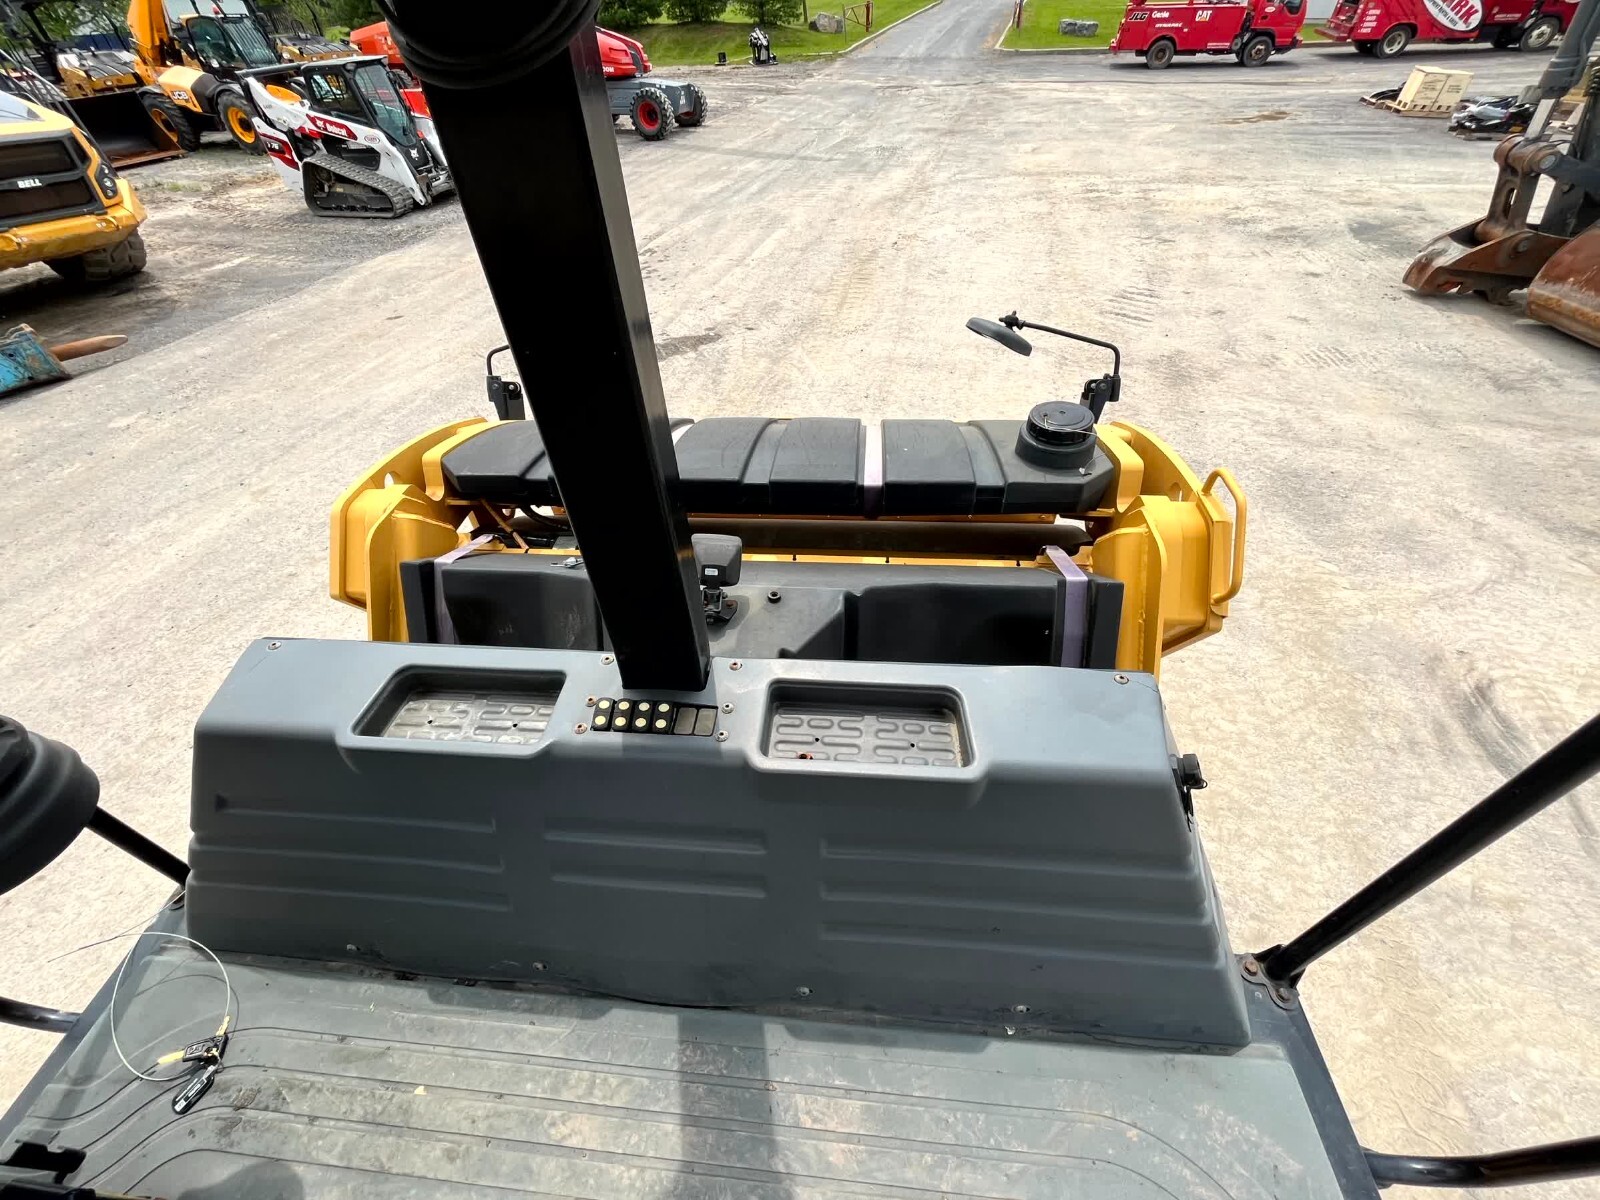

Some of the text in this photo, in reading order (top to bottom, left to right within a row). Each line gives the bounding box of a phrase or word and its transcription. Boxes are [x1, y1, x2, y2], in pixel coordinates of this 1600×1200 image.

[1128, 12, 1149, 21] JLG
[1152, 11, 1170, 19] Genie
[1196, 11, 1212, 21] CAT
[172, 91, 189, 100] JCB
[326, 123, 348, 136] Bobcat
[17, 178, 42, 189] BELL
